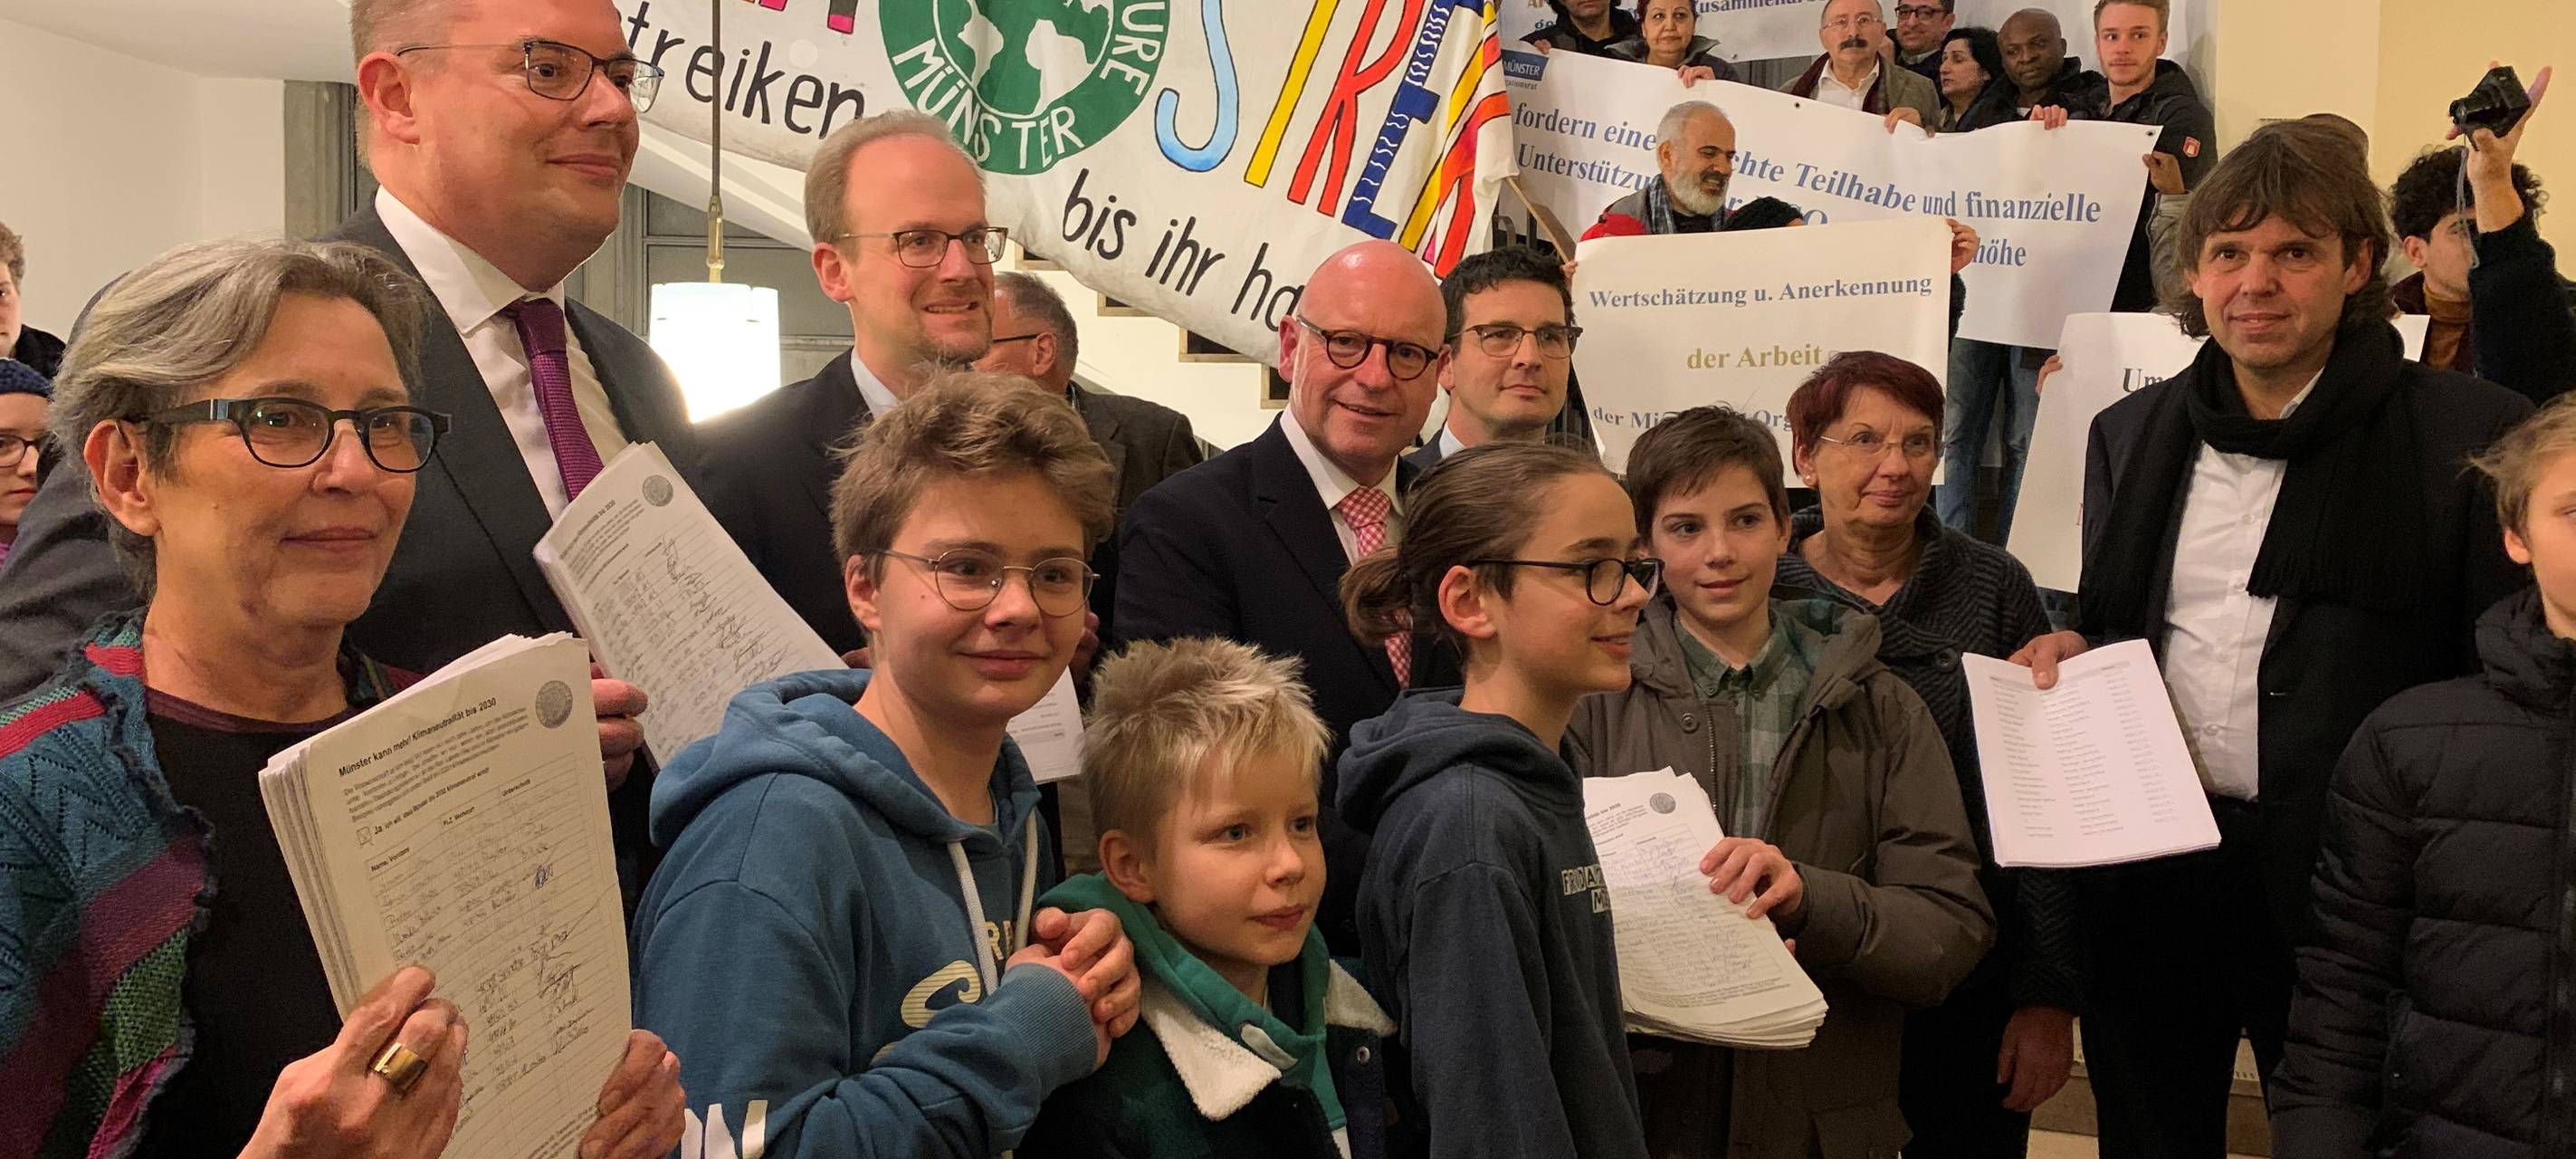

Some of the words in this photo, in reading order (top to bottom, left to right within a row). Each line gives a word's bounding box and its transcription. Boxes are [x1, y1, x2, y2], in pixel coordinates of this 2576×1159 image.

[627, 1, 865, 139] treiken
[1100, 0, 1169, 96] URE
[892, 38, 1085, 169] MÜNSTER
[1514, 102, 1597, 139] fordern
[1603, 121, 1657, 151] eine
[1795, 163, 1916, 213] Teilhabe
[1922, 191, 1957, 216] und
[1965, 191, 2101, 223] finanzielle
[1518, 143, 1653, 191] Unterstützu
[1063, 168, 1137, 260] bis
[1144, 216, 1226, 296] ihr
[1231, 242, 1305, 332] ha
[1589, 289, 1747, 308] Wertschätzung
[1754, 289, 1773, 302] u.
[1779, 277, 1932, 301] Anerkennung
[1686, 348, 1731, 369] der
[1736, 343, 1822, 369] Arbeit
[1594, 407, 1624, 426] der
[1631, 411, 1659, 429] Mi
[1753, 409, 1792, 431] Org
[339, 756, 372, 778] Münster
[372, 748, 393, 761] kann
[465, 705, 477, 717] bis
[479, 697, 497, 712] 2030
